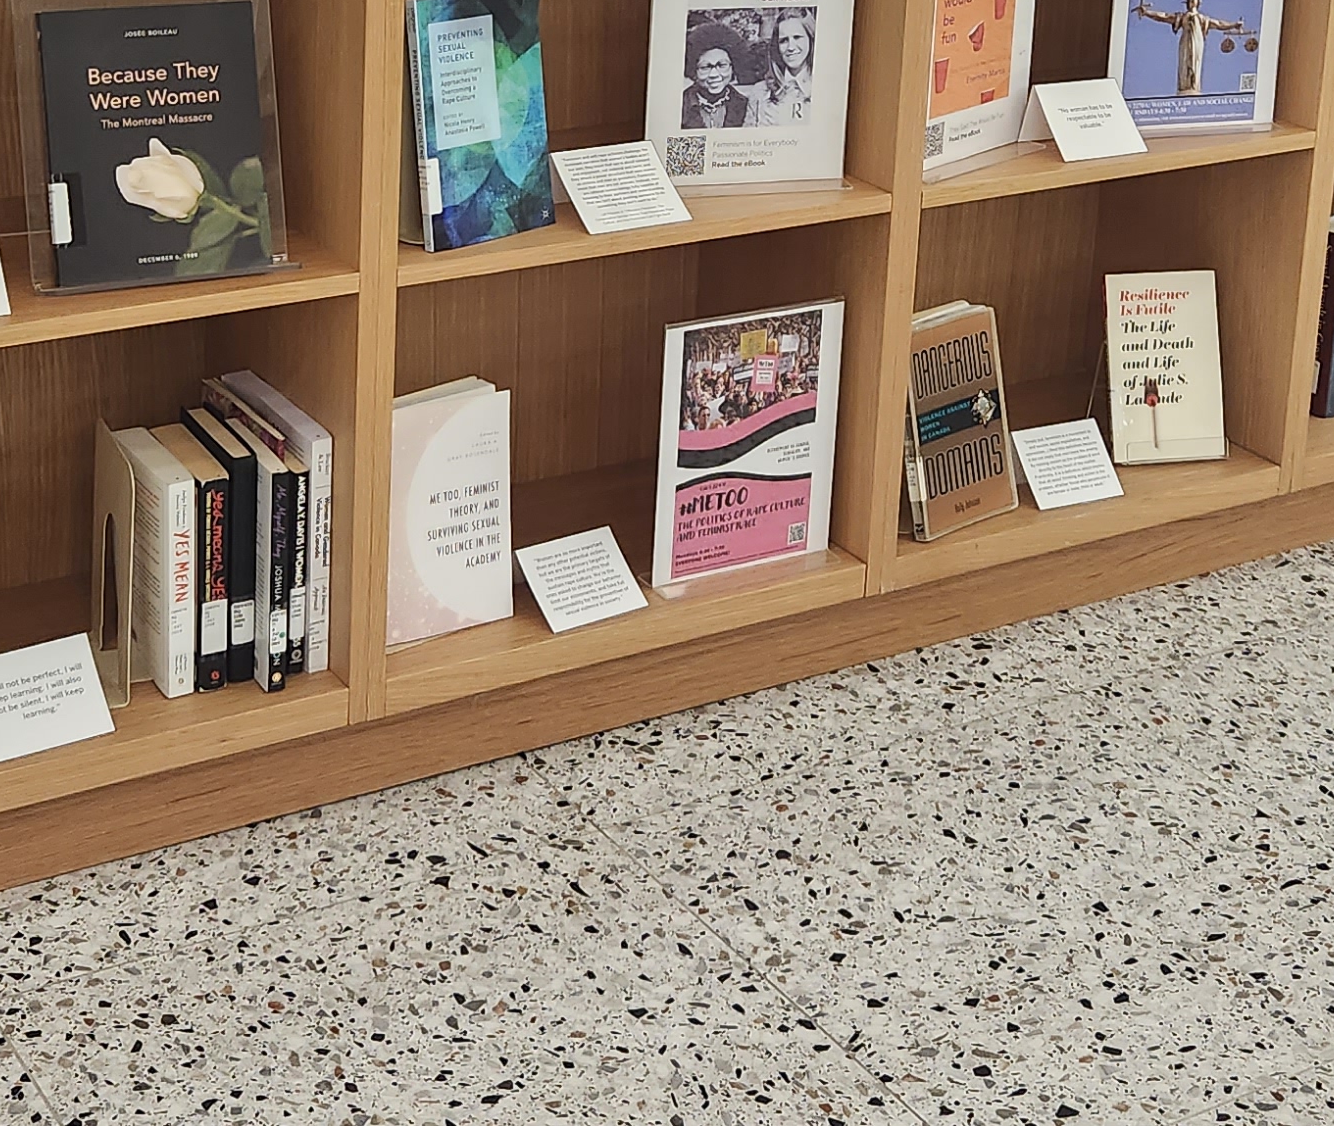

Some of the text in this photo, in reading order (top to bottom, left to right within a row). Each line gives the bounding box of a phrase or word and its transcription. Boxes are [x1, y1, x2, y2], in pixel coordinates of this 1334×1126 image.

[942, 14, 955, 26] be
[124, 28, 178, 38] JOSÉE BOILEAU
[437, 28, 483, 42] PREVENTING
[941, 31, 956, 45] fun
[438, 42, 466, 53] SEXUAL
[438, 51, 474, 64] VIOLENCE
[87, 62, 220, 86] Because They
[440, 66, 482, 77] Interdisciplinary
[441, 78, 470, 87] Approaches
[89, 87, 220, 110] Were Women
[101, 113, 213, 130] The Montreal Massacre
[744, 159, 765, 167] eBook
[1119, 289, 1190, 302] Resilience
[1120, 303, 1176, 316] Is Futile
[1121, 319, 1176, 335] The Life
[1121, 336, 1194, 352] and Death
[912, 330, 992, 400] DANGEROUS
[1122, 355, 1180, 370] and Life
[1123, 373, 1189, 390] of Julie S.
[919, 401, 971, 424] VIOLENCE AGAINST
[920, 421, 941, 433] WOMEN
[921, 426, 951, 441] IN CANADA
[925, 433, 1004, 501] DOMAINS
[429, 480, 500, 505] ME TOO, FEMINIST
[449, 498, 500, 519] THEORY, AND
[679, 486, 749, 517] #METOO
[678, 497, 806, 532] THE POLITICS OF RAPE CULTURE
[427, 516, 500, 542] SURVIVING SEXUAL
[677, 530, 696, 543] AND
[698, 523, 734, 537] FEMINIST
[173, 529, 190, 557] YES
[436, 533, 501, 557] VIOLENCE IN THE
[465, 551, 502, 569] ACADEMY
[174, 561, 190, 603] MEAN
[274, 564, 283, 602] JOSHUA
